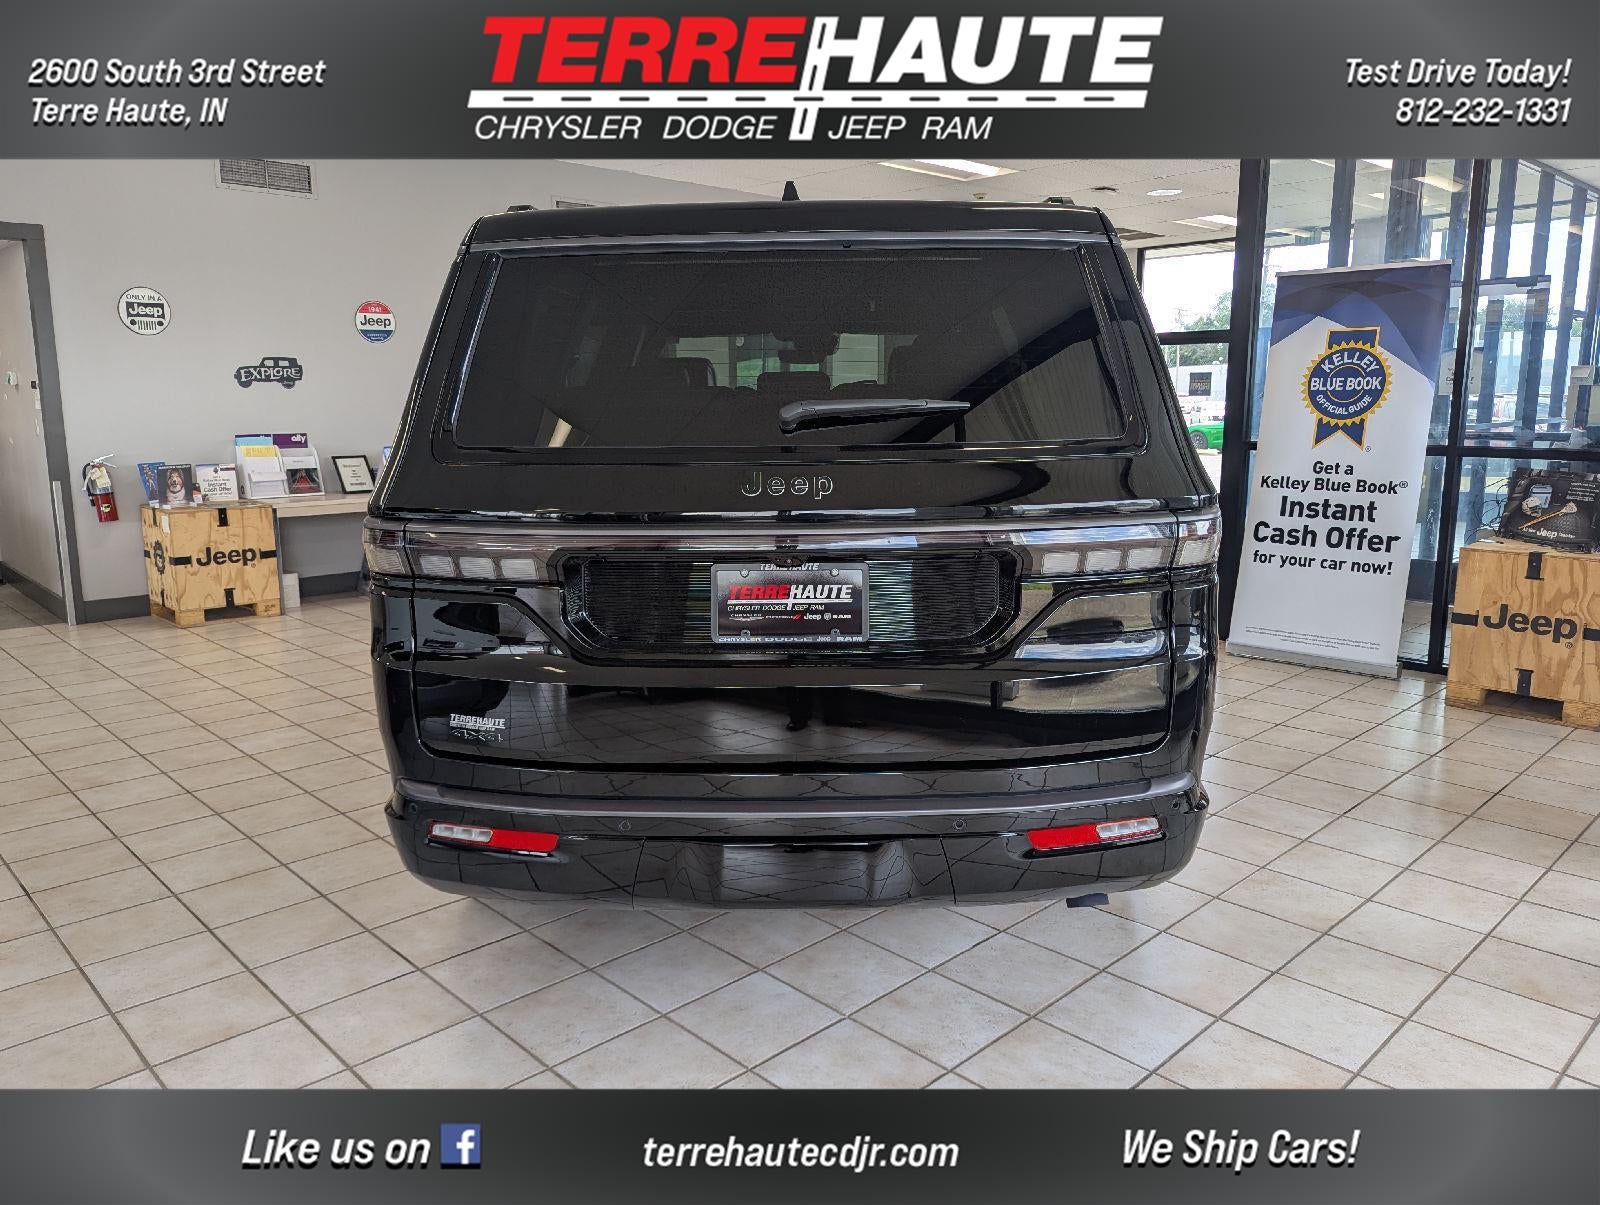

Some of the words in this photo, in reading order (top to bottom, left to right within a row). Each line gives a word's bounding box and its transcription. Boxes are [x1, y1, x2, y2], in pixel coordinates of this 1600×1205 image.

[126, 293, 146, 301] ONLY
[147, 294, 156, 302] IN
[128, 302, 163, 318] Jeep
[360, 314, 392, 329] Jeep
[1320, 351, 1380, 374] KELLEY
[240, 367, 301, 382] EXPLORE
[1310, 377, 1345, 391] BLUE
[1346, 376, 1382, 391] BOOK
[1316, 394, 1348, 415] OFFICIAL
[1348, 394, 1374, 414] GUIDE
[291, 434, 307, 444] ally
[1312, 460, 1341, 475] Get
[1344, 464, 1354, 475] a
[741, 471, 834, 500] Jeep
[1260, 475, 1310, 493] Kelley
[1314, 477, 1351, 493] Blue
[1279, 495, 1378, 523] Instant
[1253, 520, 1318, 548] Cash
[1325, 526, 1401, 553] Offer
[1536, 527, 1558, 539] Jeep
[196, 546, 257, 567] Jeep
[1253, 550, 1276, 564] for
[1279, 554, 1316, 568] your
[1320, 558, 1347, 571] car
[1350, 561, 1393, 576] now!
[803, 612, 822, 621] Jeep
[1483, 604, 1578, 643] Jeep
